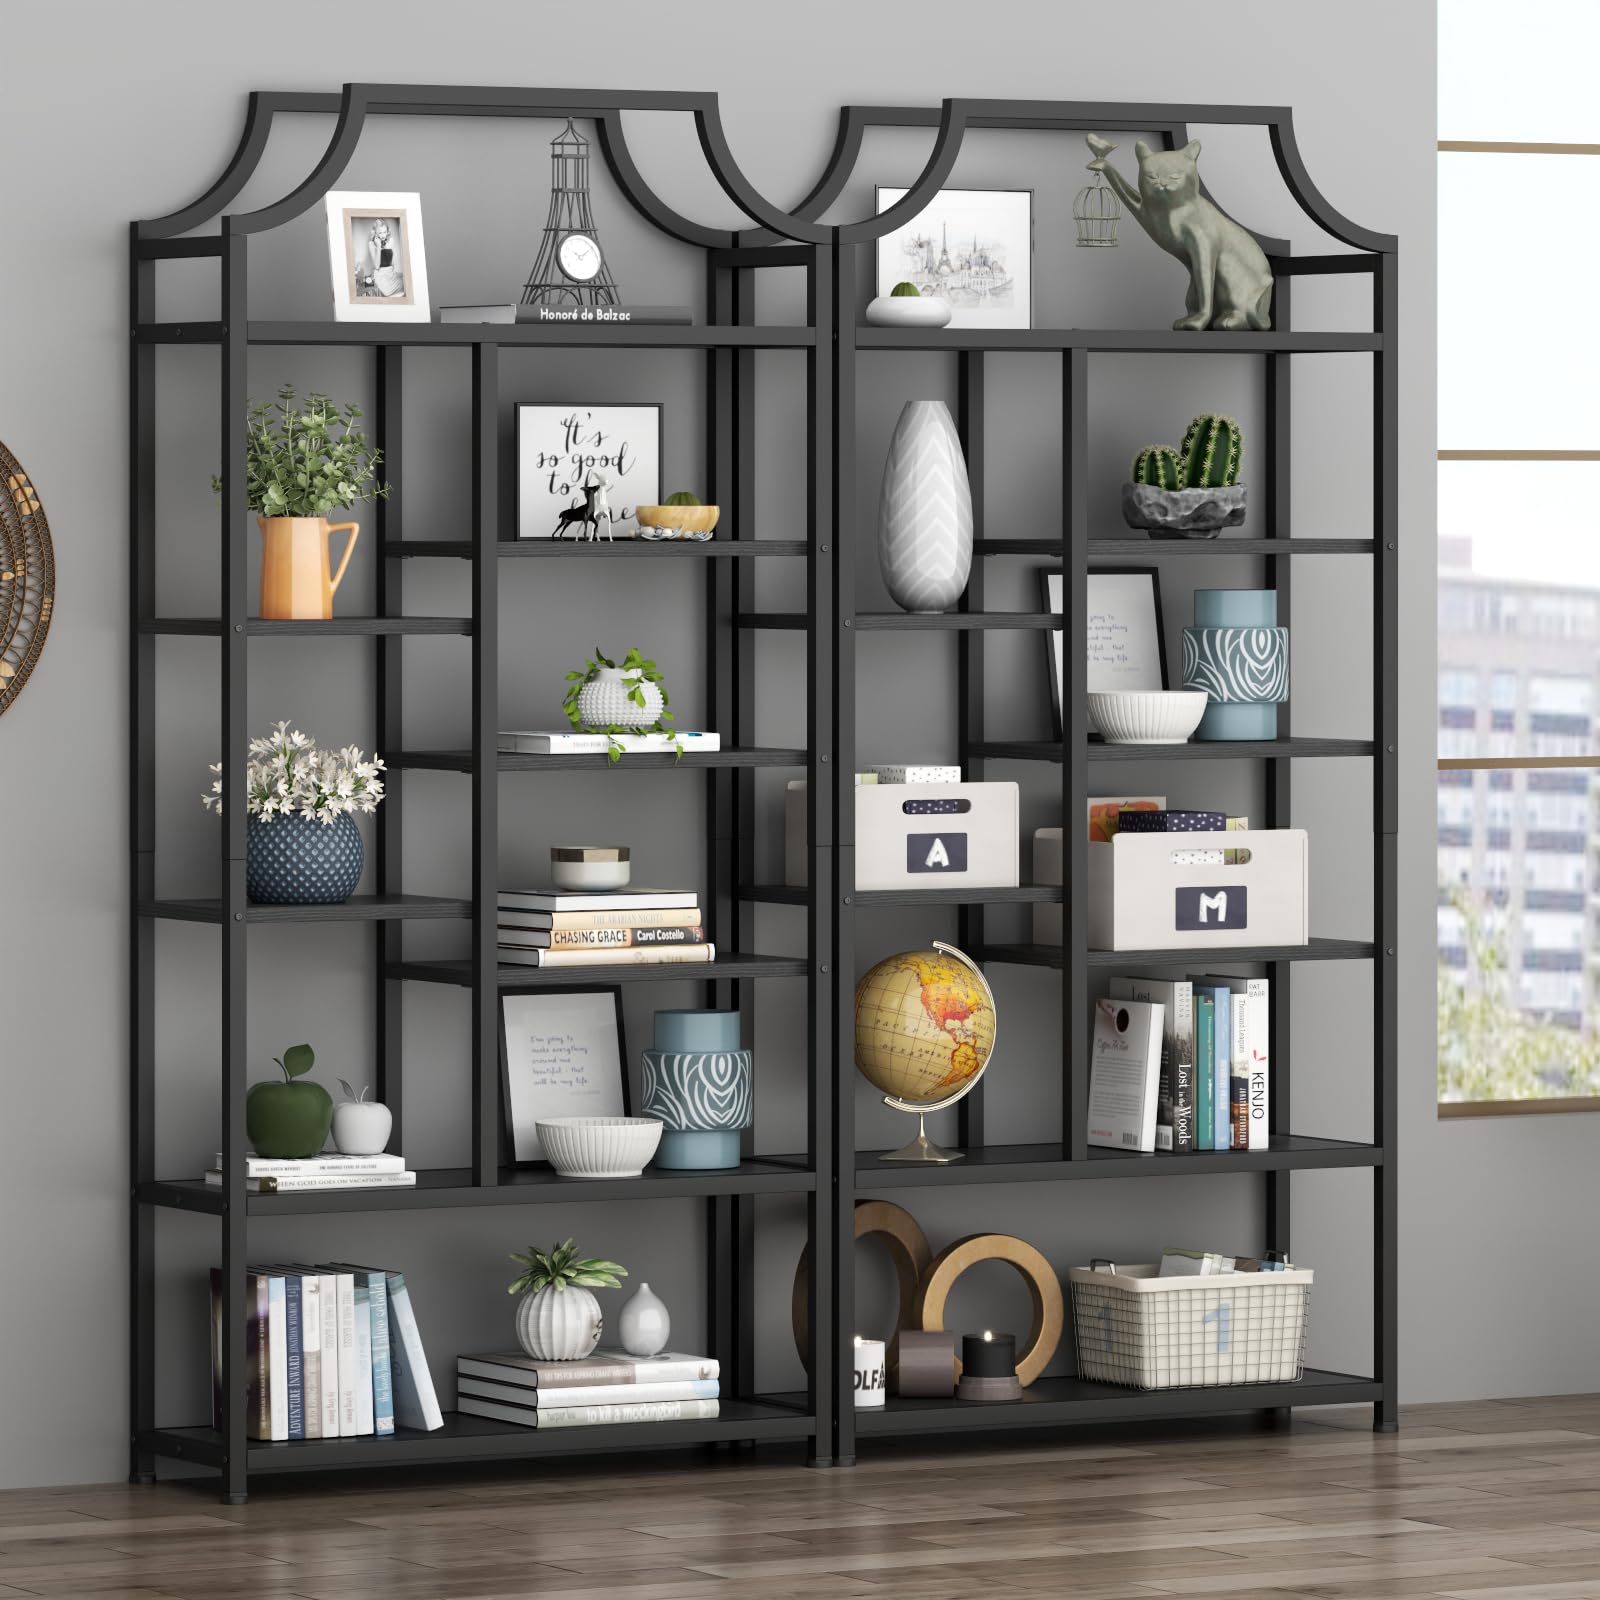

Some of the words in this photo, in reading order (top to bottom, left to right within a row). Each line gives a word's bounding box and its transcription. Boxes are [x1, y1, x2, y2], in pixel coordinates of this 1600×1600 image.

[540, 307, 578, 320] Honoré
[581, 307, 594, 320] de
[596, 307, 631, 321] Balzac
[560, 412, 608, 453] It's
[536, 451, 565, 469] so
[570, 441, 637, 483] good
[546, 470, 576, 495] to
[924, 836, 950, 868] A
[1198, 890, 1228, 923] M
[554, 931, 595, 944] CHASING
[597, 930, 627, 943] GRACE
[637, 929, 656, 941] Carol
[656, 928, 685, 941] Costello
[1178, 1063, 1192, 1088] Lost
[1251, 1072, 1265, 1119] KENJO
[1178, 1106, 1192, 1145] Woods
[369, 1282, 386, 1318] sebold
[287, 1327, 298, 1353] JONATHAN
[1203, 1302, 1231, 1353] 1
[288, 1355, 301, 1387] INWARD
[288, 1388, 301, 1435] ADVENTURE
